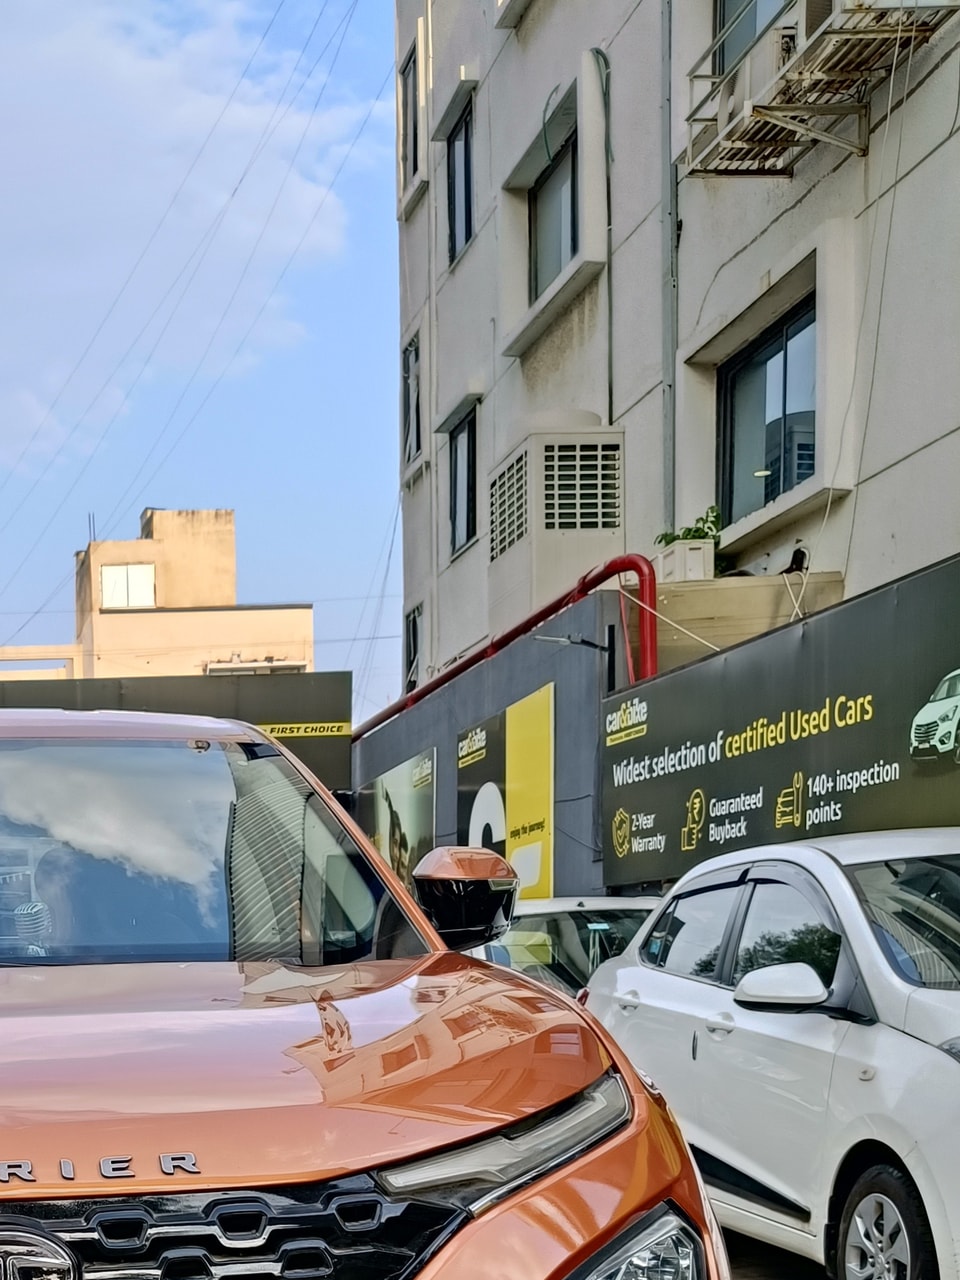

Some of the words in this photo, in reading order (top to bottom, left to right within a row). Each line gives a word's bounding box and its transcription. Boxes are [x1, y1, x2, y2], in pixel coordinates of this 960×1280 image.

[606, 697, 648, 733] car&bike
[269, 726, 302, 735] FIRST
[303, 725, 344, 734] CHOICE
[613, 755, 651, 787] Widest
[652, 741, 706, 777] selection
[708, 730, 724, 763] of
[725, 711, 786, 758] certified
[790, 697, 830, 740] Used
[834, 694, 873, 728] Cars
[806, 774, 834, 798] 140+
[836, 760, 900, 793] inspection
[709, 786, 763, 817] Guaranteed
[805, 801, 842, 830] points
[631, 813, 656, 831] 2-Year
[708, 816, 747, 844] Buyback
[631, 833, 667, 853] Warranty
